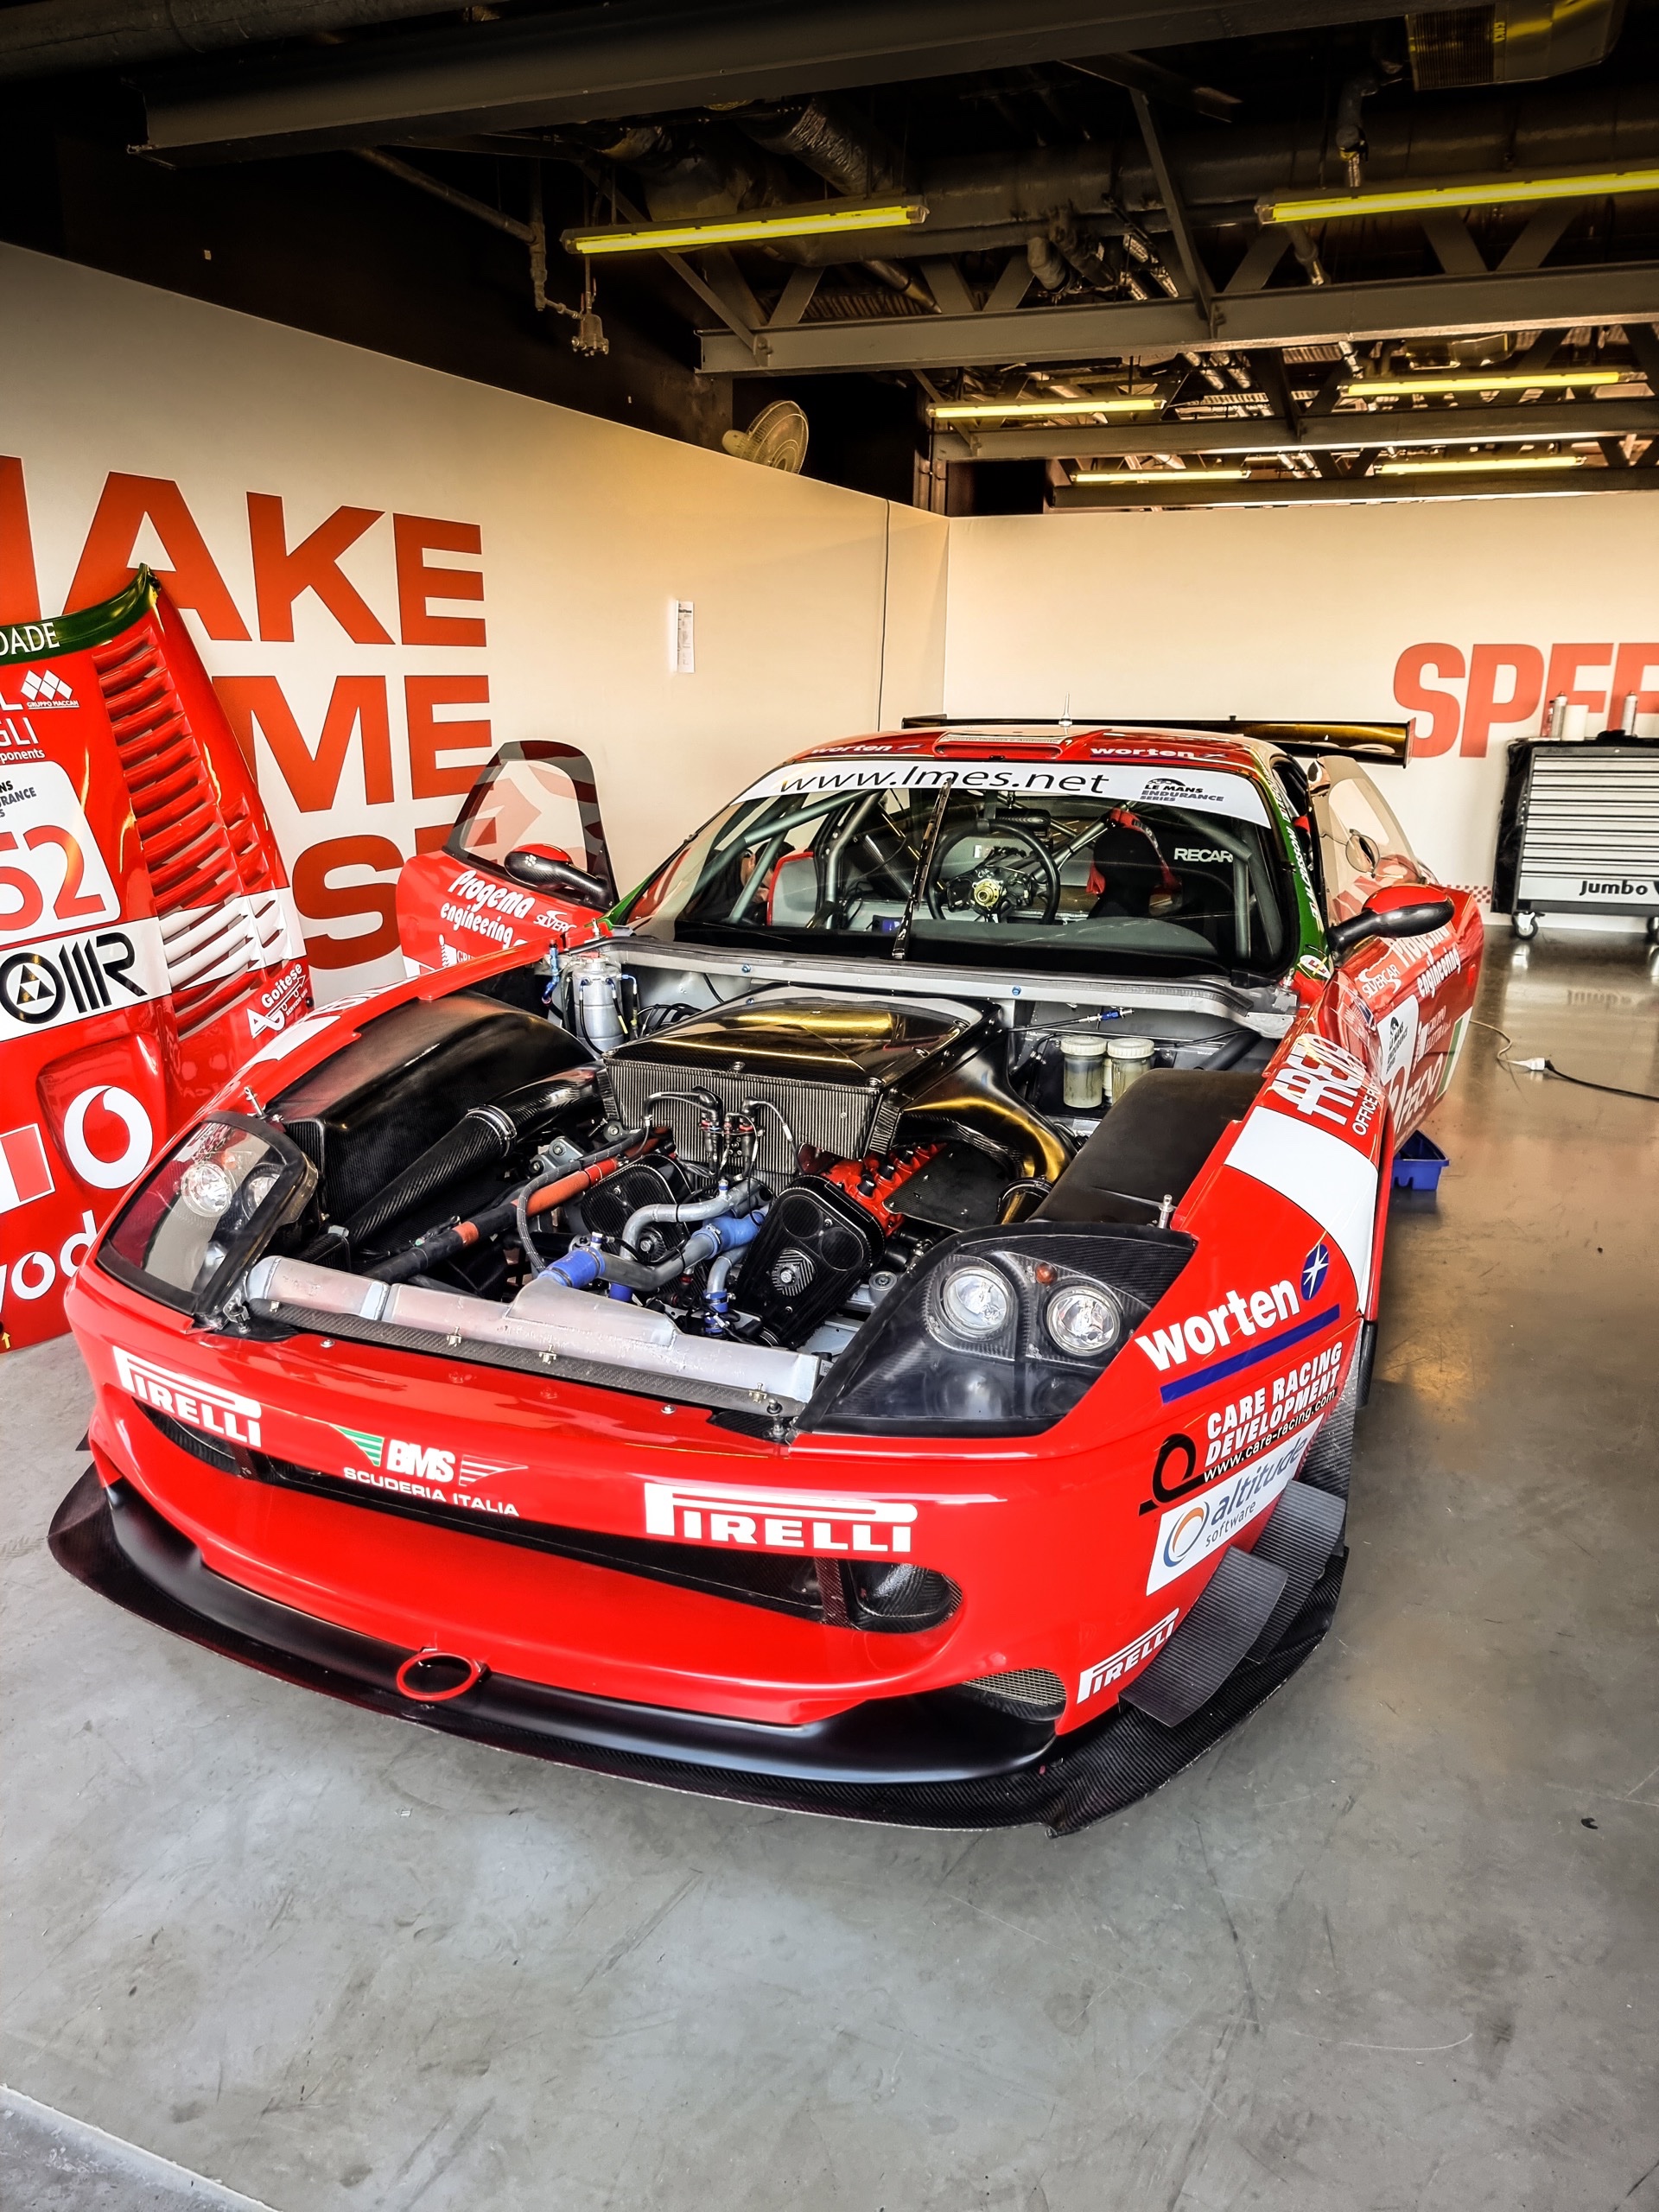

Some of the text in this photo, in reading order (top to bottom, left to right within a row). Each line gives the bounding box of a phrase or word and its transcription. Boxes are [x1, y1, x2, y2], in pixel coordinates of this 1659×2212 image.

[811, 744, 893, 755] worten
[1090, 747, 1195, 758] worten
[779, 766, 1109, 794] www.lmes.net
[1141, 790, 1224, 802] ENDURANCE
[448, 870, 536, 920] Progema
[1579, 880, 1649, 897] Jumbo
[440, 902, 514, 950] engineering
[261, 963, 302, 1008] Goitese
[1362, 963, 1401, 999] SILVERCAR
[1417, 943, 1461, 999] engineering
[1351, 1095, 1379, 1136] OFFICE
[1135, 1279, 1300, 1372] worten
[112, 1345, 262, 1448] PIRELLI
[1207, 1342, 1343, 1440] CARE RACING
[1204, 1389, 1336, 1483] www.care-racing.com
[1205, 1364, 1340, 1468] DEVELOPMENT
[387, 1439, 455, 1483] BMS
[1211, 1435, 1308, 1526] altitude
[344, 1467, 520, 1517] SCUDERIA ITALIA
[644, 1483, 918, 1553] PIRELLI
[1205, 1501, 1256, 1548] software
[1077, 1607, 1180, 1704] PIRELLI
